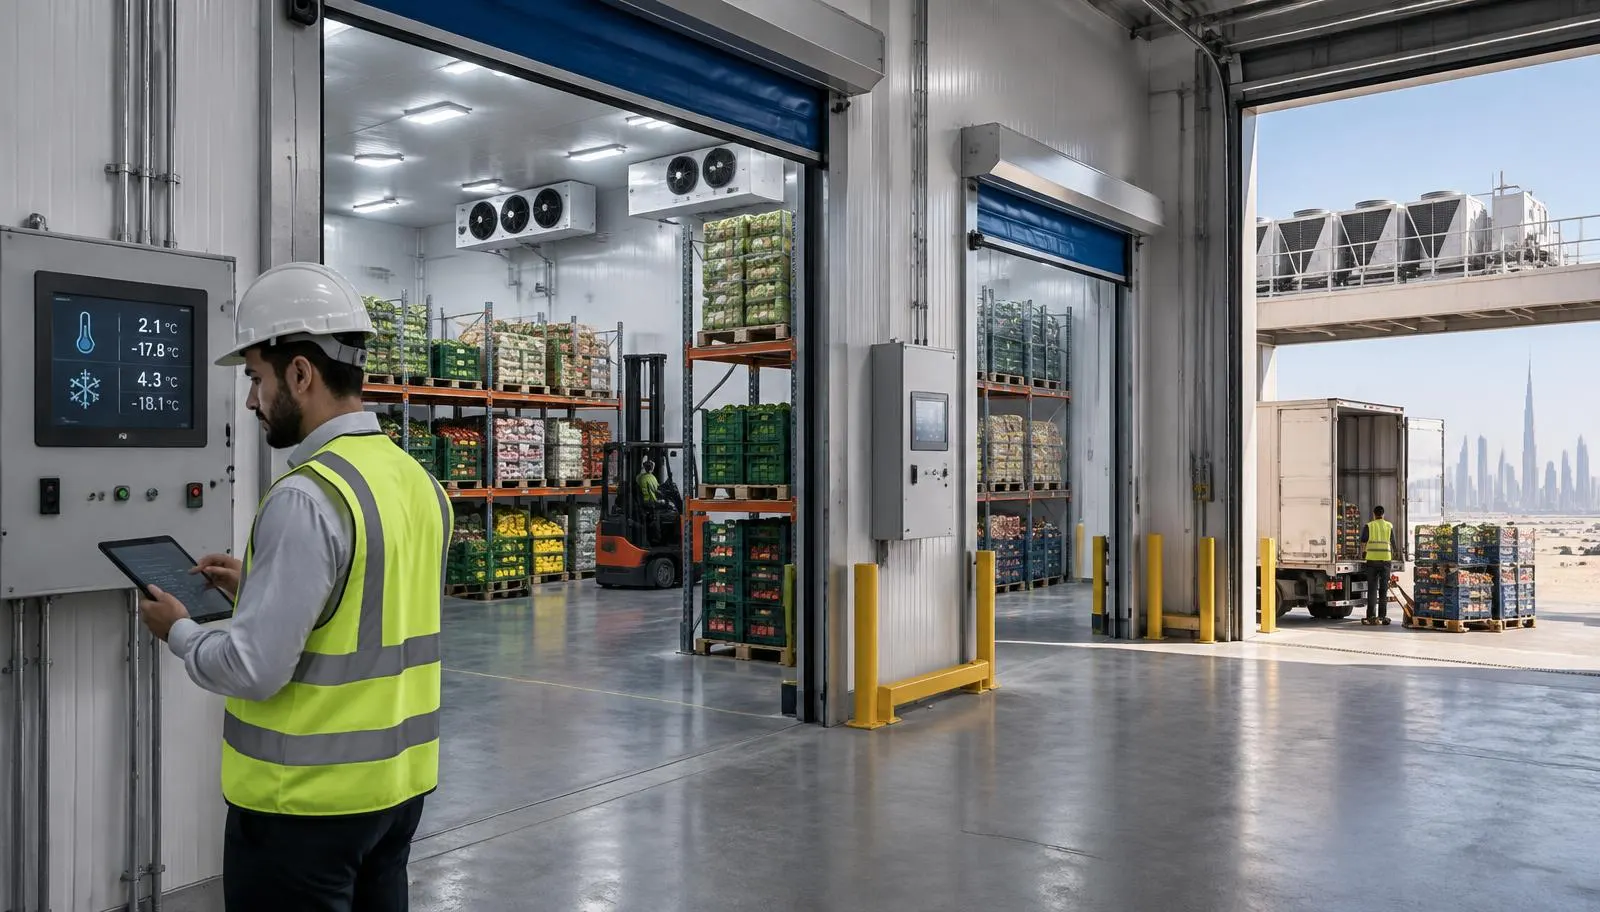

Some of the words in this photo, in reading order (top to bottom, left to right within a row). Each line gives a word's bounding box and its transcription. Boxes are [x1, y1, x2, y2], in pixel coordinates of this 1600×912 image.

[138, 318, 160, 334] 2.1
[131, 342, 165, 357] -17.8
[137, 371, 161, 387] 4.3
[131, 397, 163, 411] -18.1
